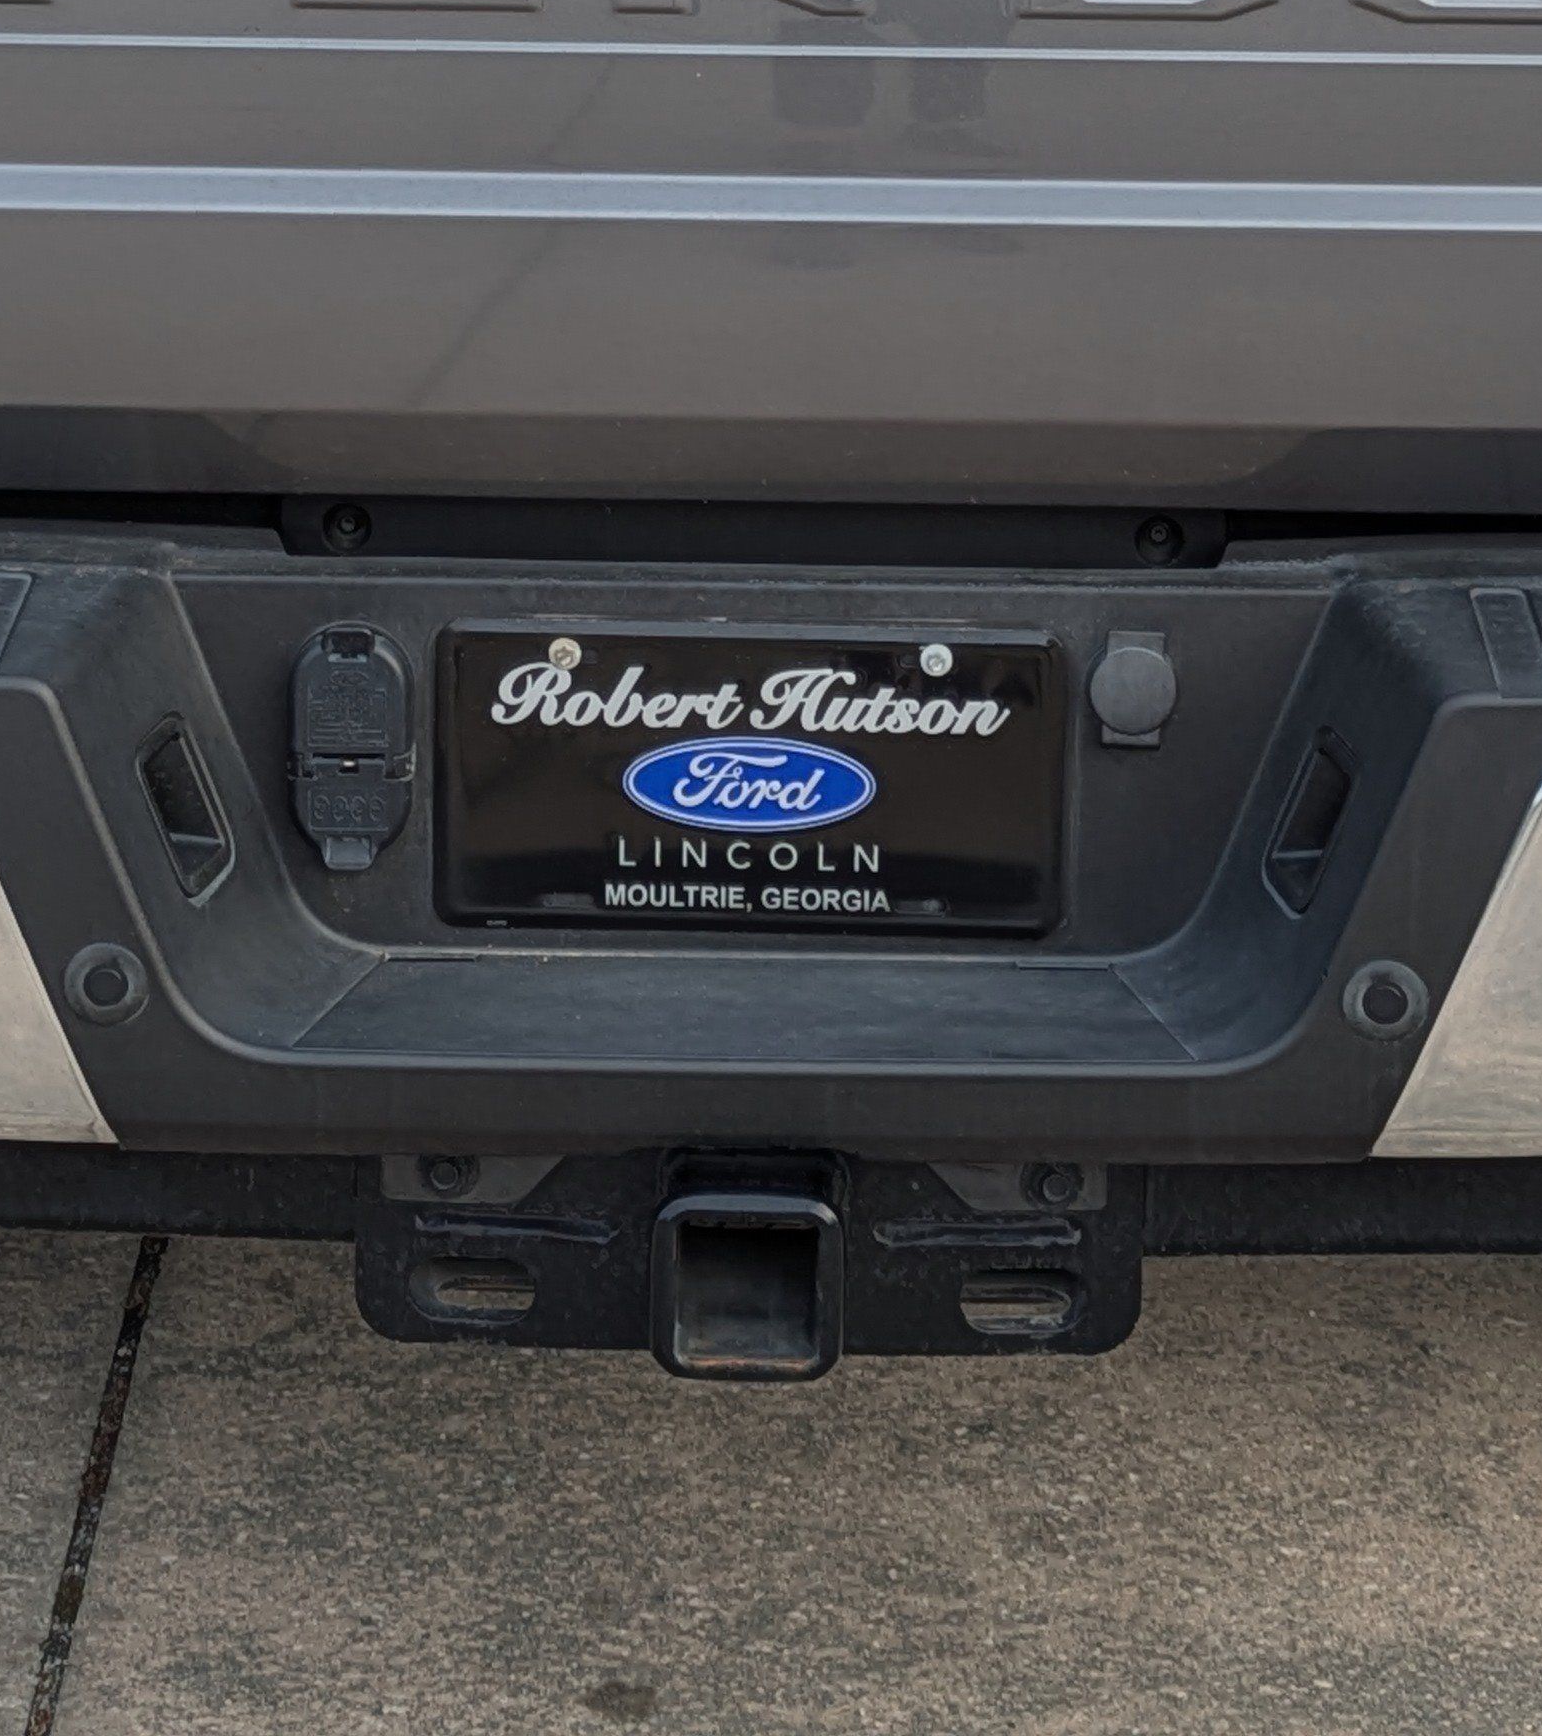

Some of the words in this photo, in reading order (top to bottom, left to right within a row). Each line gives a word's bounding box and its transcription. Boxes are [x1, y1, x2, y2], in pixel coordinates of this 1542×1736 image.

[491, 661, 744, 730] Robert
[749, 667, 1011, 737] Hutson
[672, 751, 825, 812] Ford
[618, 835, 880, 873] LINCOLN
[604, 884, 754, 914] MOULTRIE,
[761, 887, 891, 914] GEORGIA
